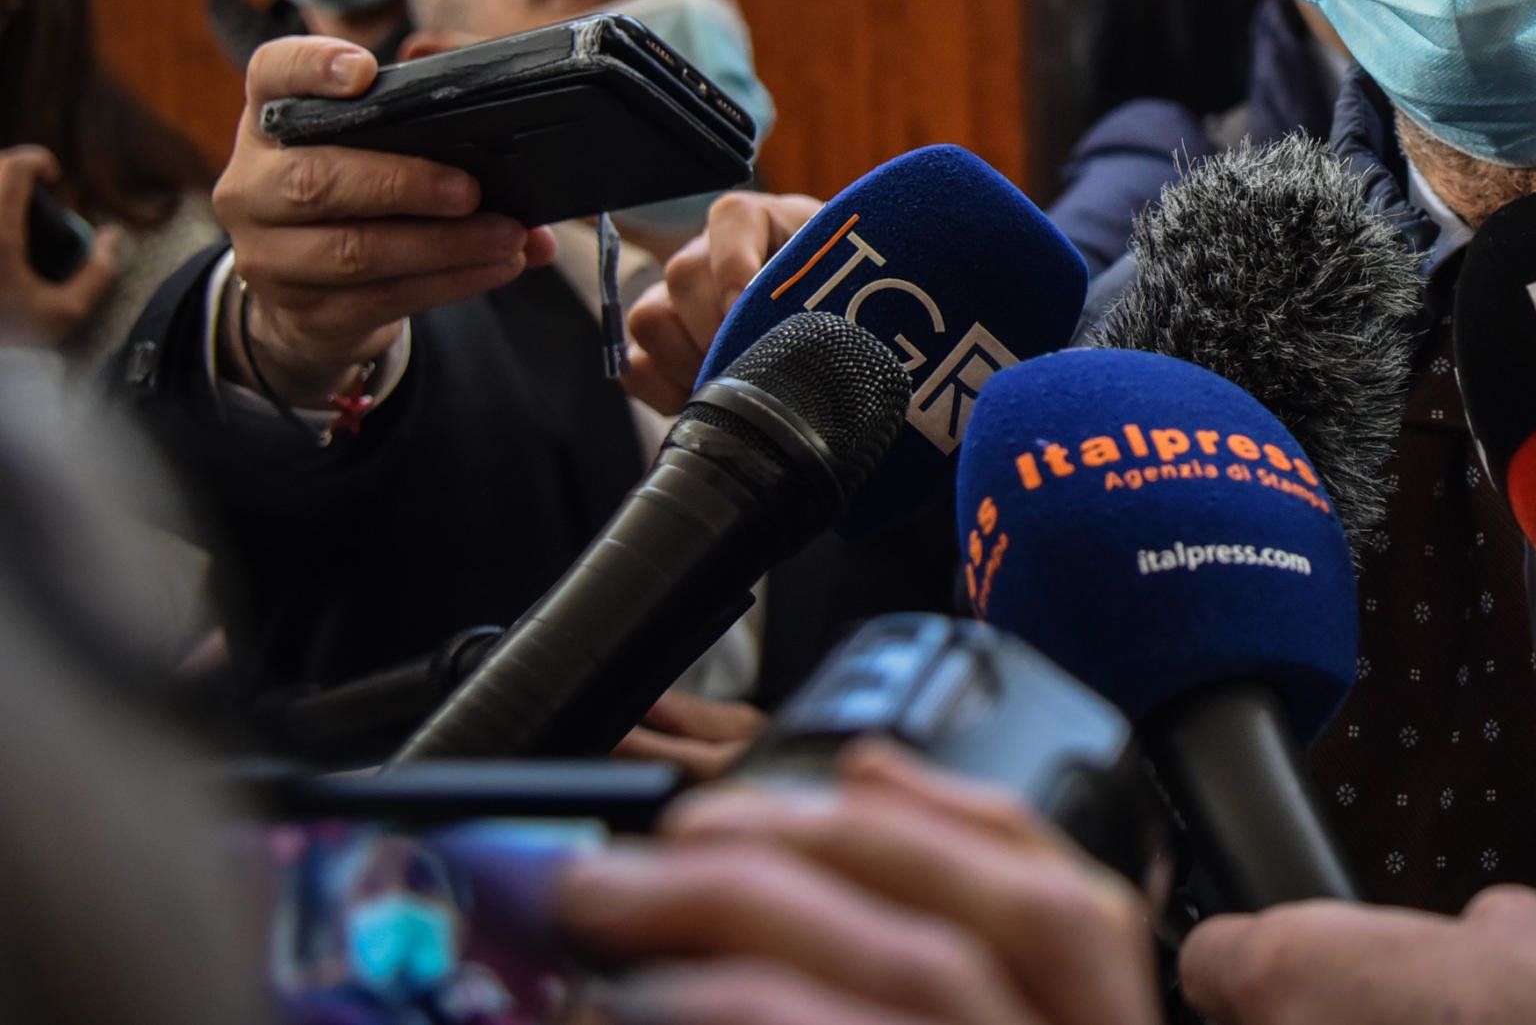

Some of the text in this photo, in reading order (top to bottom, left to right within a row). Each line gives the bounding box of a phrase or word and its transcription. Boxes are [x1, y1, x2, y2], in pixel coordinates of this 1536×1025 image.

[1015, 423, 1319, 490] Italpress
[1105, 459, 1219, 491] Agenzia
[1226, 464, 1251, 481] di
[1138, 541, 1312, 575] italpress.com
